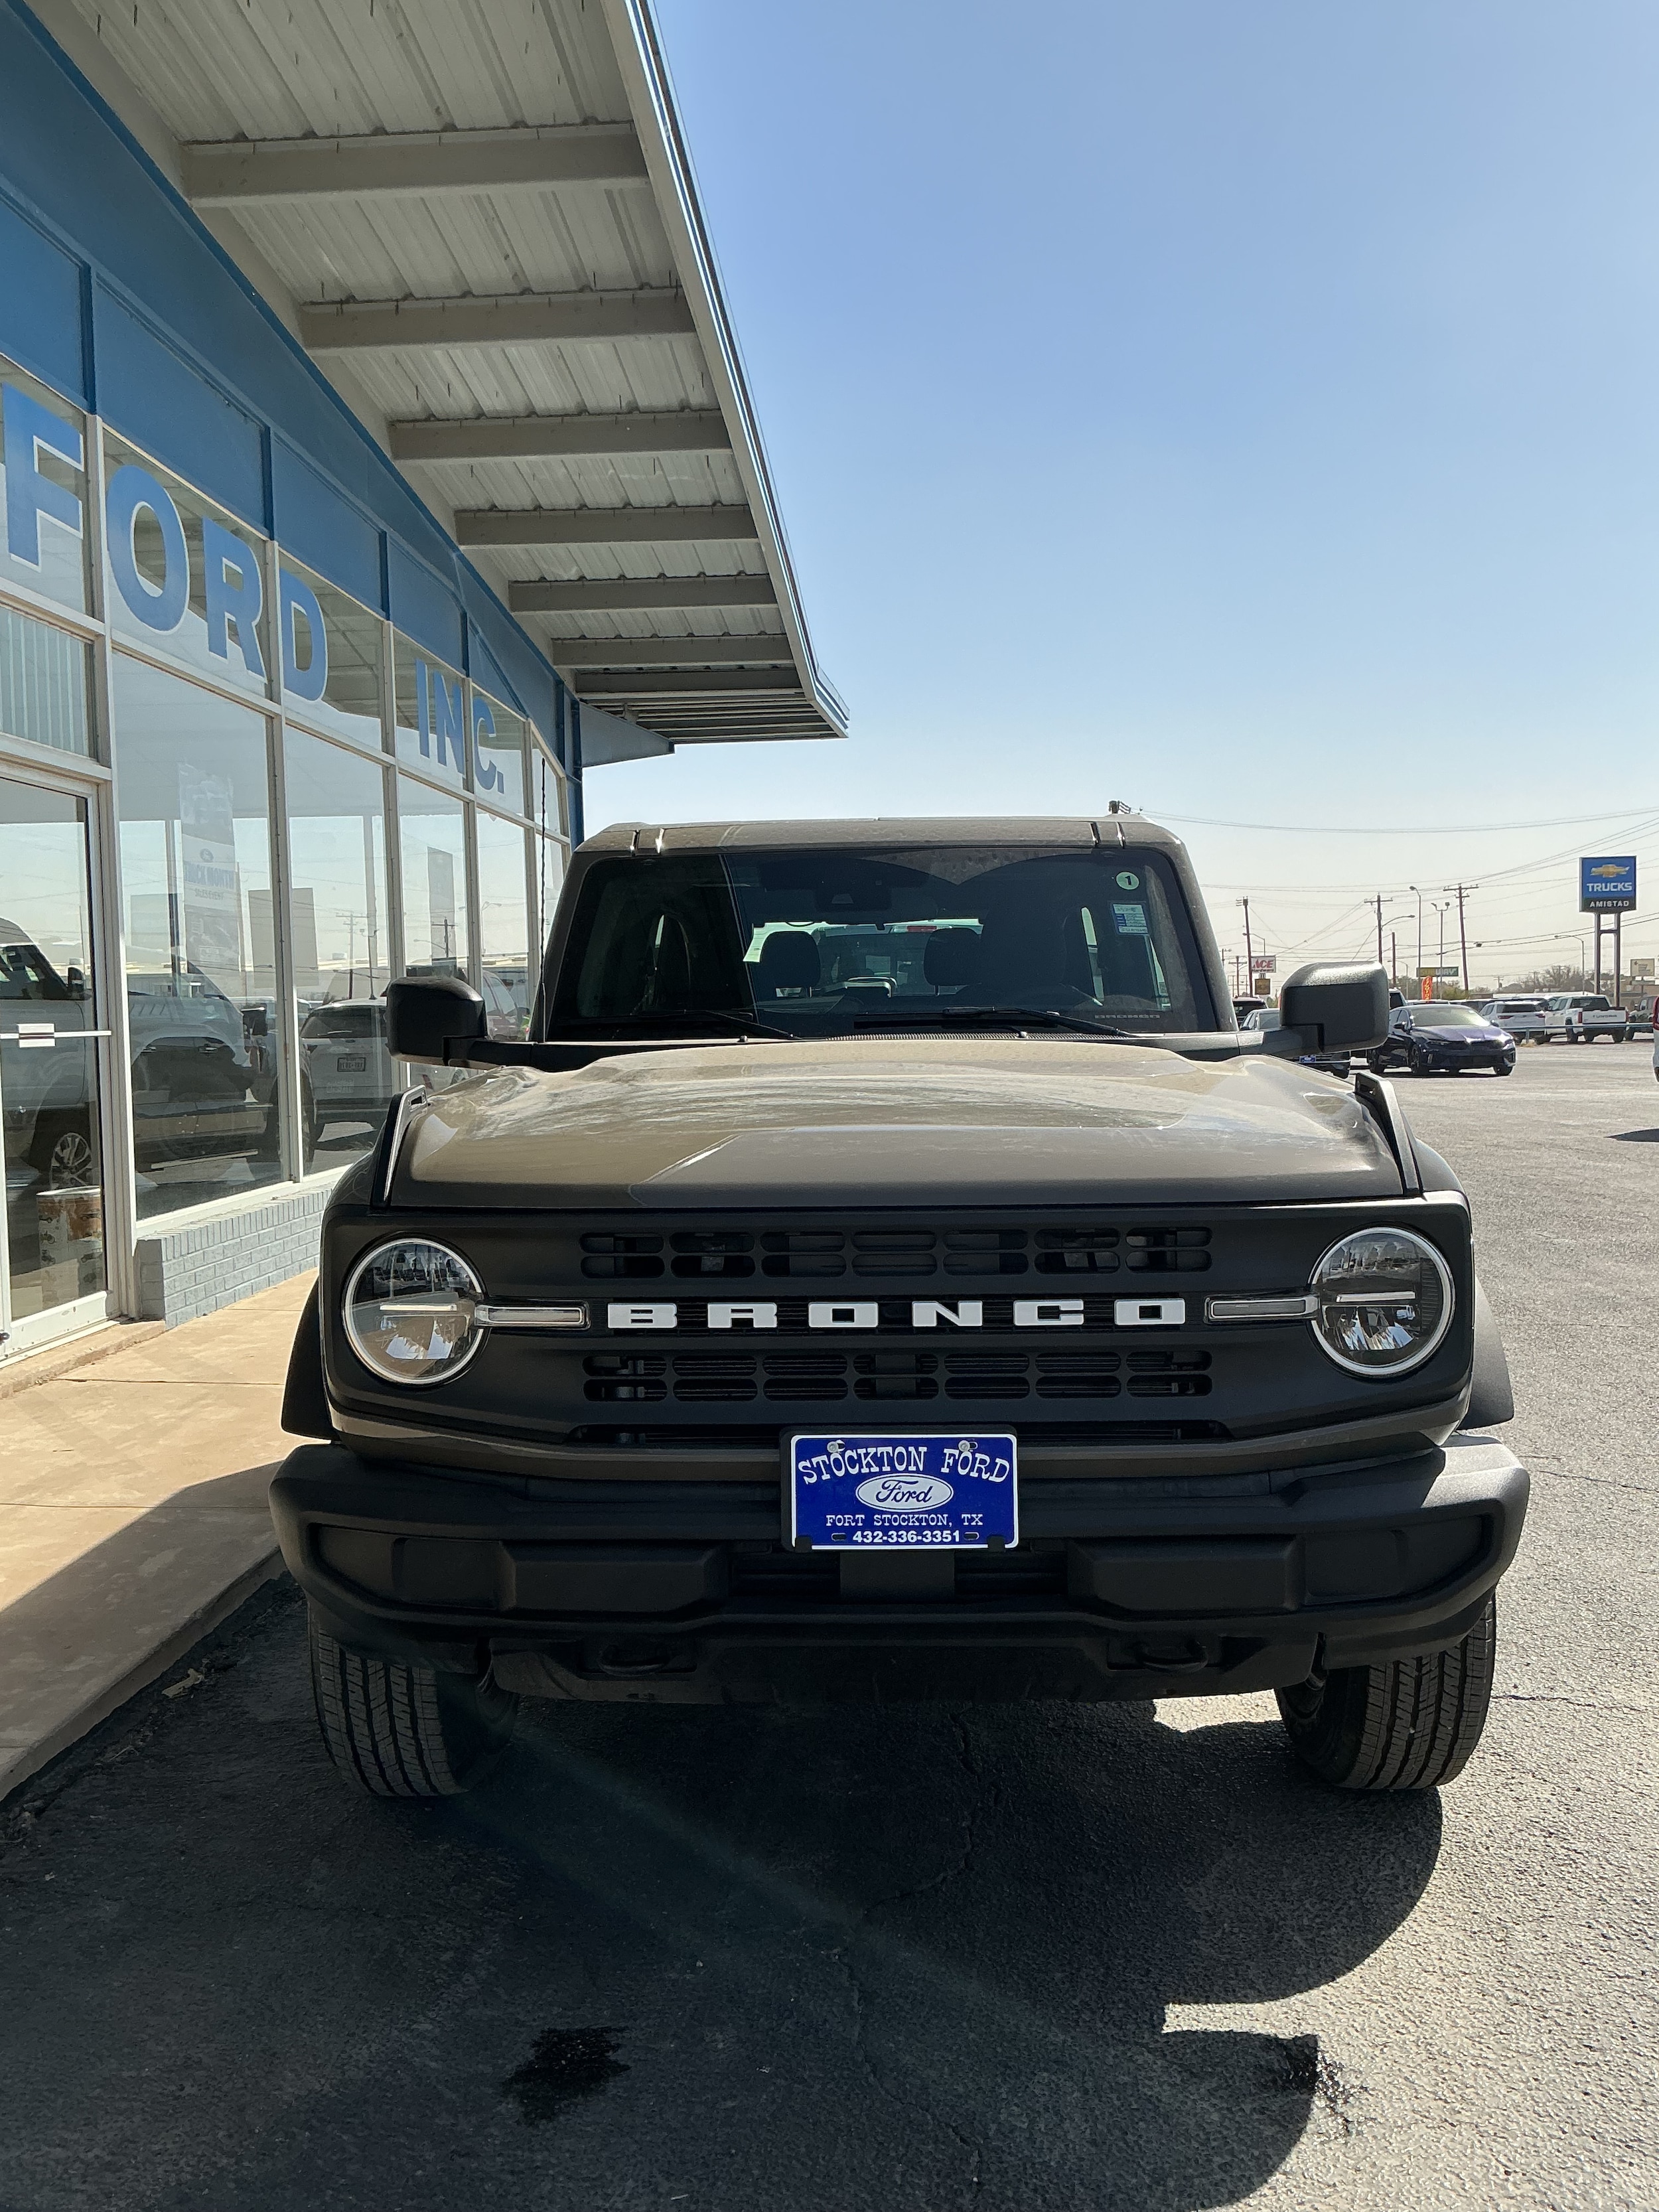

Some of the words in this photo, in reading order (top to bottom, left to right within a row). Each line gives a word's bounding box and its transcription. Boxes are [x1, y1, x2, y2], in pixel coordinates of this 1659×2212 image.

[1, 380, 328, 702] FORD
[415, 657, 505, 794] INC.
[1125, 875, 1132, 886] 1
[1587, 882, 1632, 892] TRUCKS
[1252, 958, 1273, 968] ACE
[607, 1299, 1186, 1328] BRONCO
[798, 1446, 928, 1485] STOCKTON
[941, 1448, 1010, 1483] FORD
[875, 1479, 934, 1503] Ford
[826, 1514, 865, 1526] FORT
[873, 1514, 953, 1527] STOCKTON,
[962, 1514, 983, 1526] TX
[852, 1530, 960, 1543] 432-336-3351
